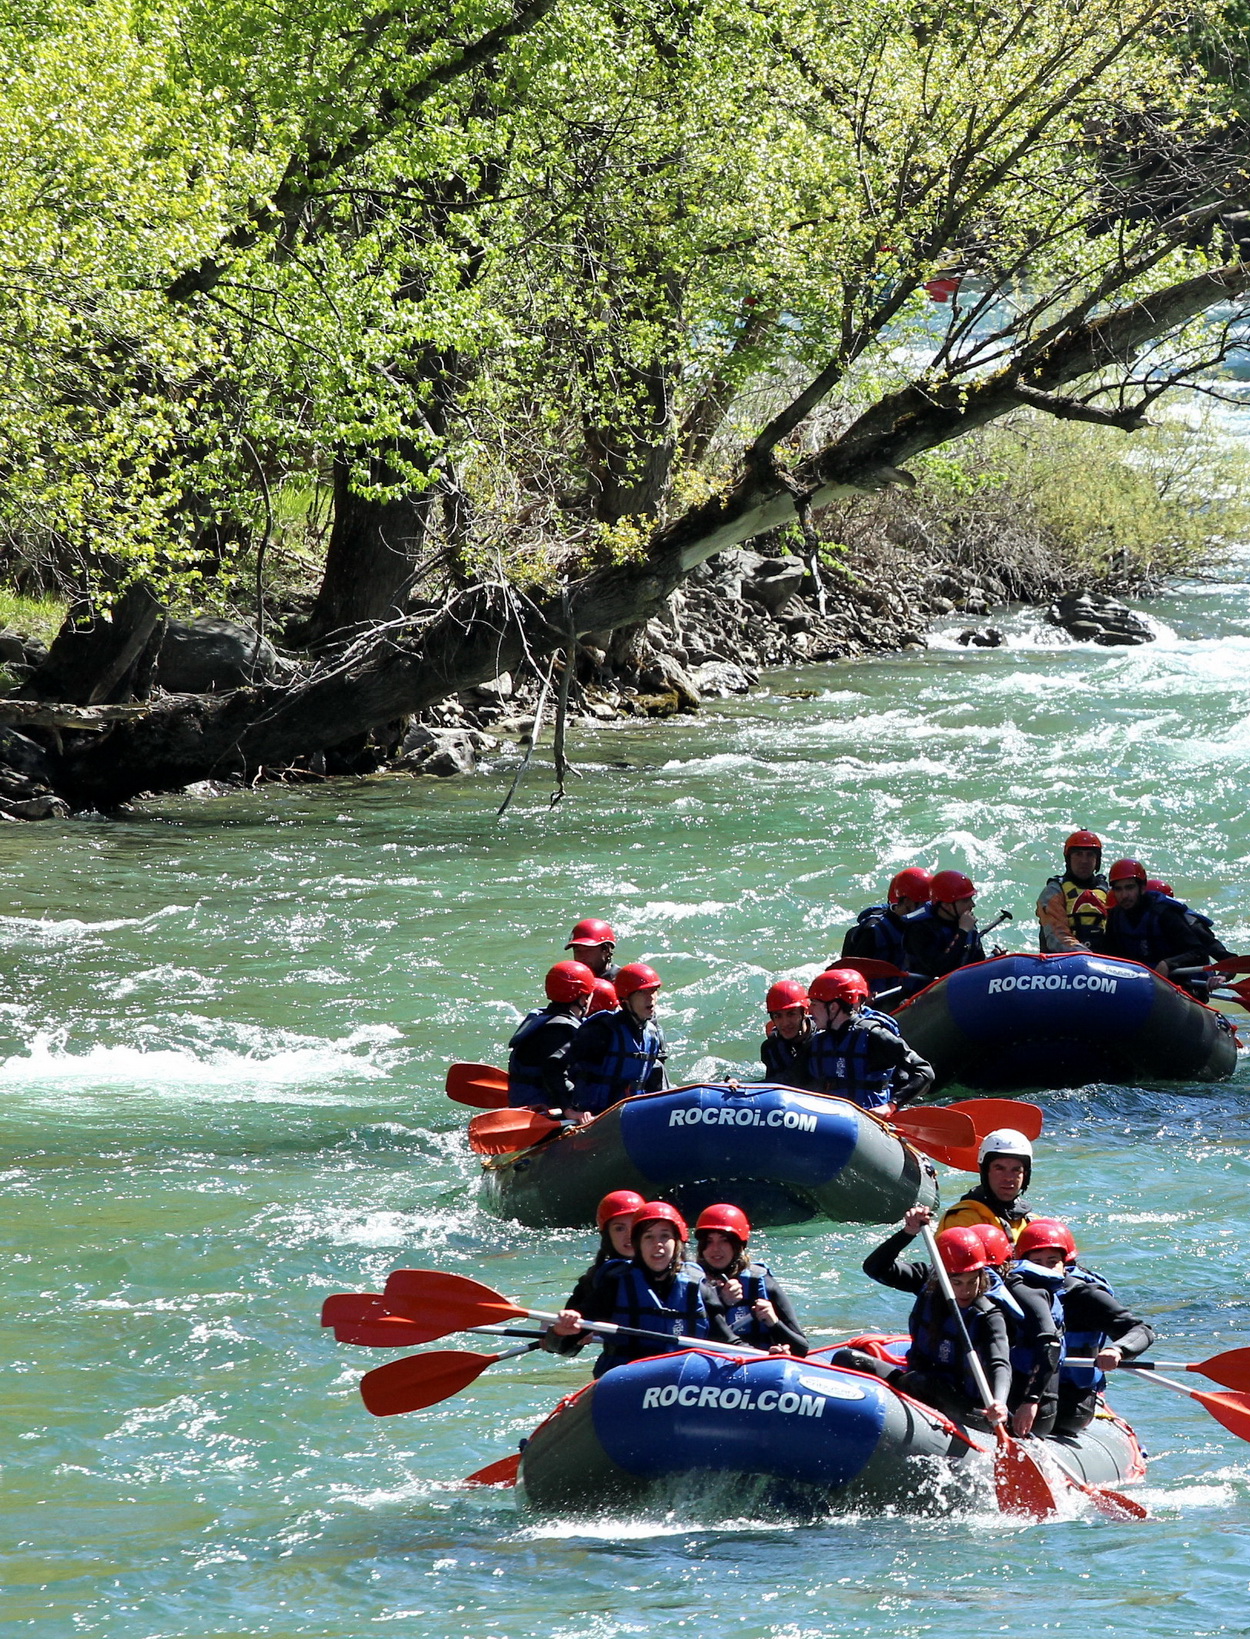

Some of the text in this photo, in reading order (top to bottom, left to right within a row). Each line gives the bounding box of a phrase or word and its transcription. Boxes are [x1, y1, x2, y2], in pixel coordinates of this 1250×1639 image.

[989, 976, 1117, 994] ROCROi.COM
[669, 1108, 817, 1132] ROCROi.COM
[643, 1385, 826, 1418] ROCROi.COM
